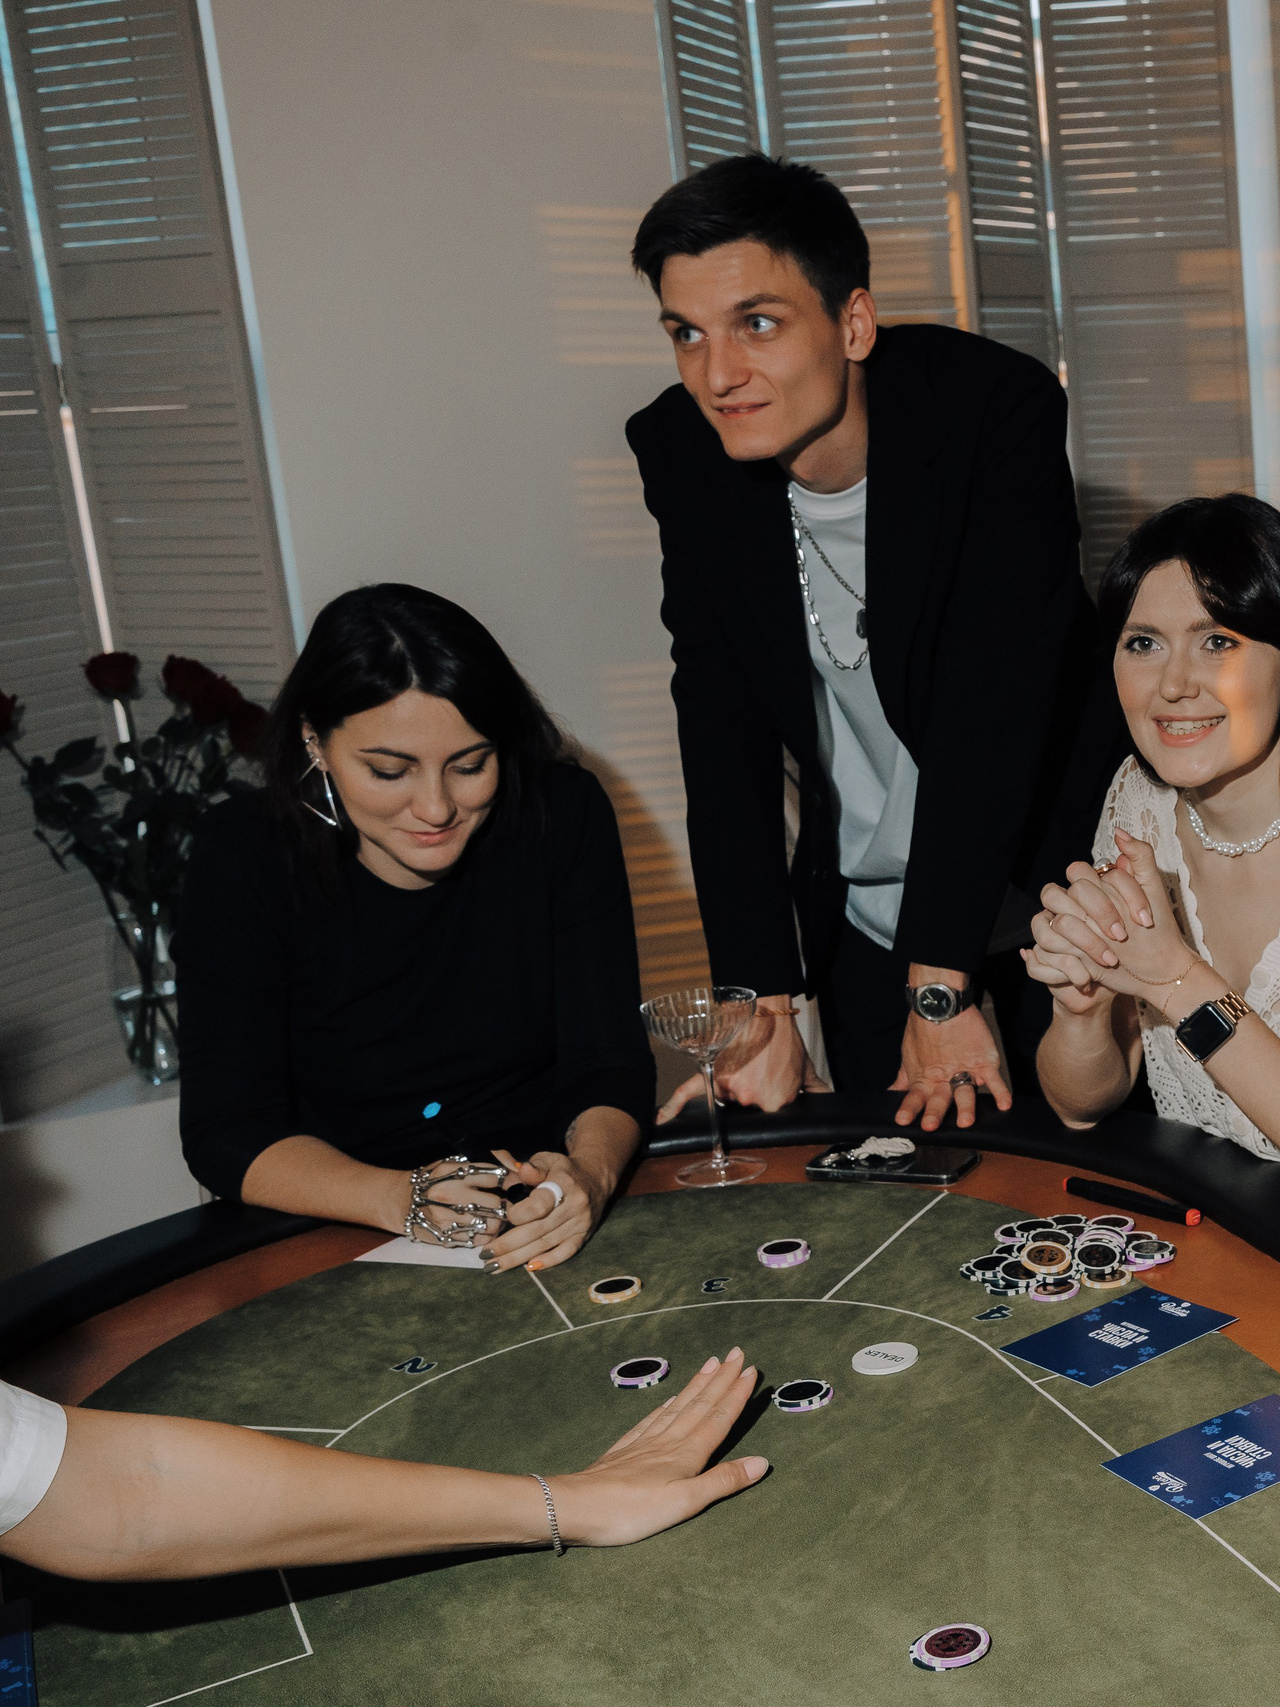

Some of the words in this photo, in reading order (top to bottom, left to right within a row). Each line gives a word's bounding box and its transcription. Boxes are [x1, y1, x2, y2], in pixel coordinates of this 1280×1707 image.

[702, 1277, 732, 1294] 3
[972, 1303, 1013, 1321] 4
[1088, 1329, 1133, 1348] СТАВКИ
[1101, 1322, 1139, 1340] ЧИСЛА
[1134, 1335, 1149, 1343] И
[864, 1349, 905, 1362] DEALER
[390, 1356, 438, 1374] 2
[1206, 1440, 1226, 1450] И
[1224, 1434, 1273, 1460] СТАВКИ
[1216, 1444, 1257, 1468] ЧИСЛА
